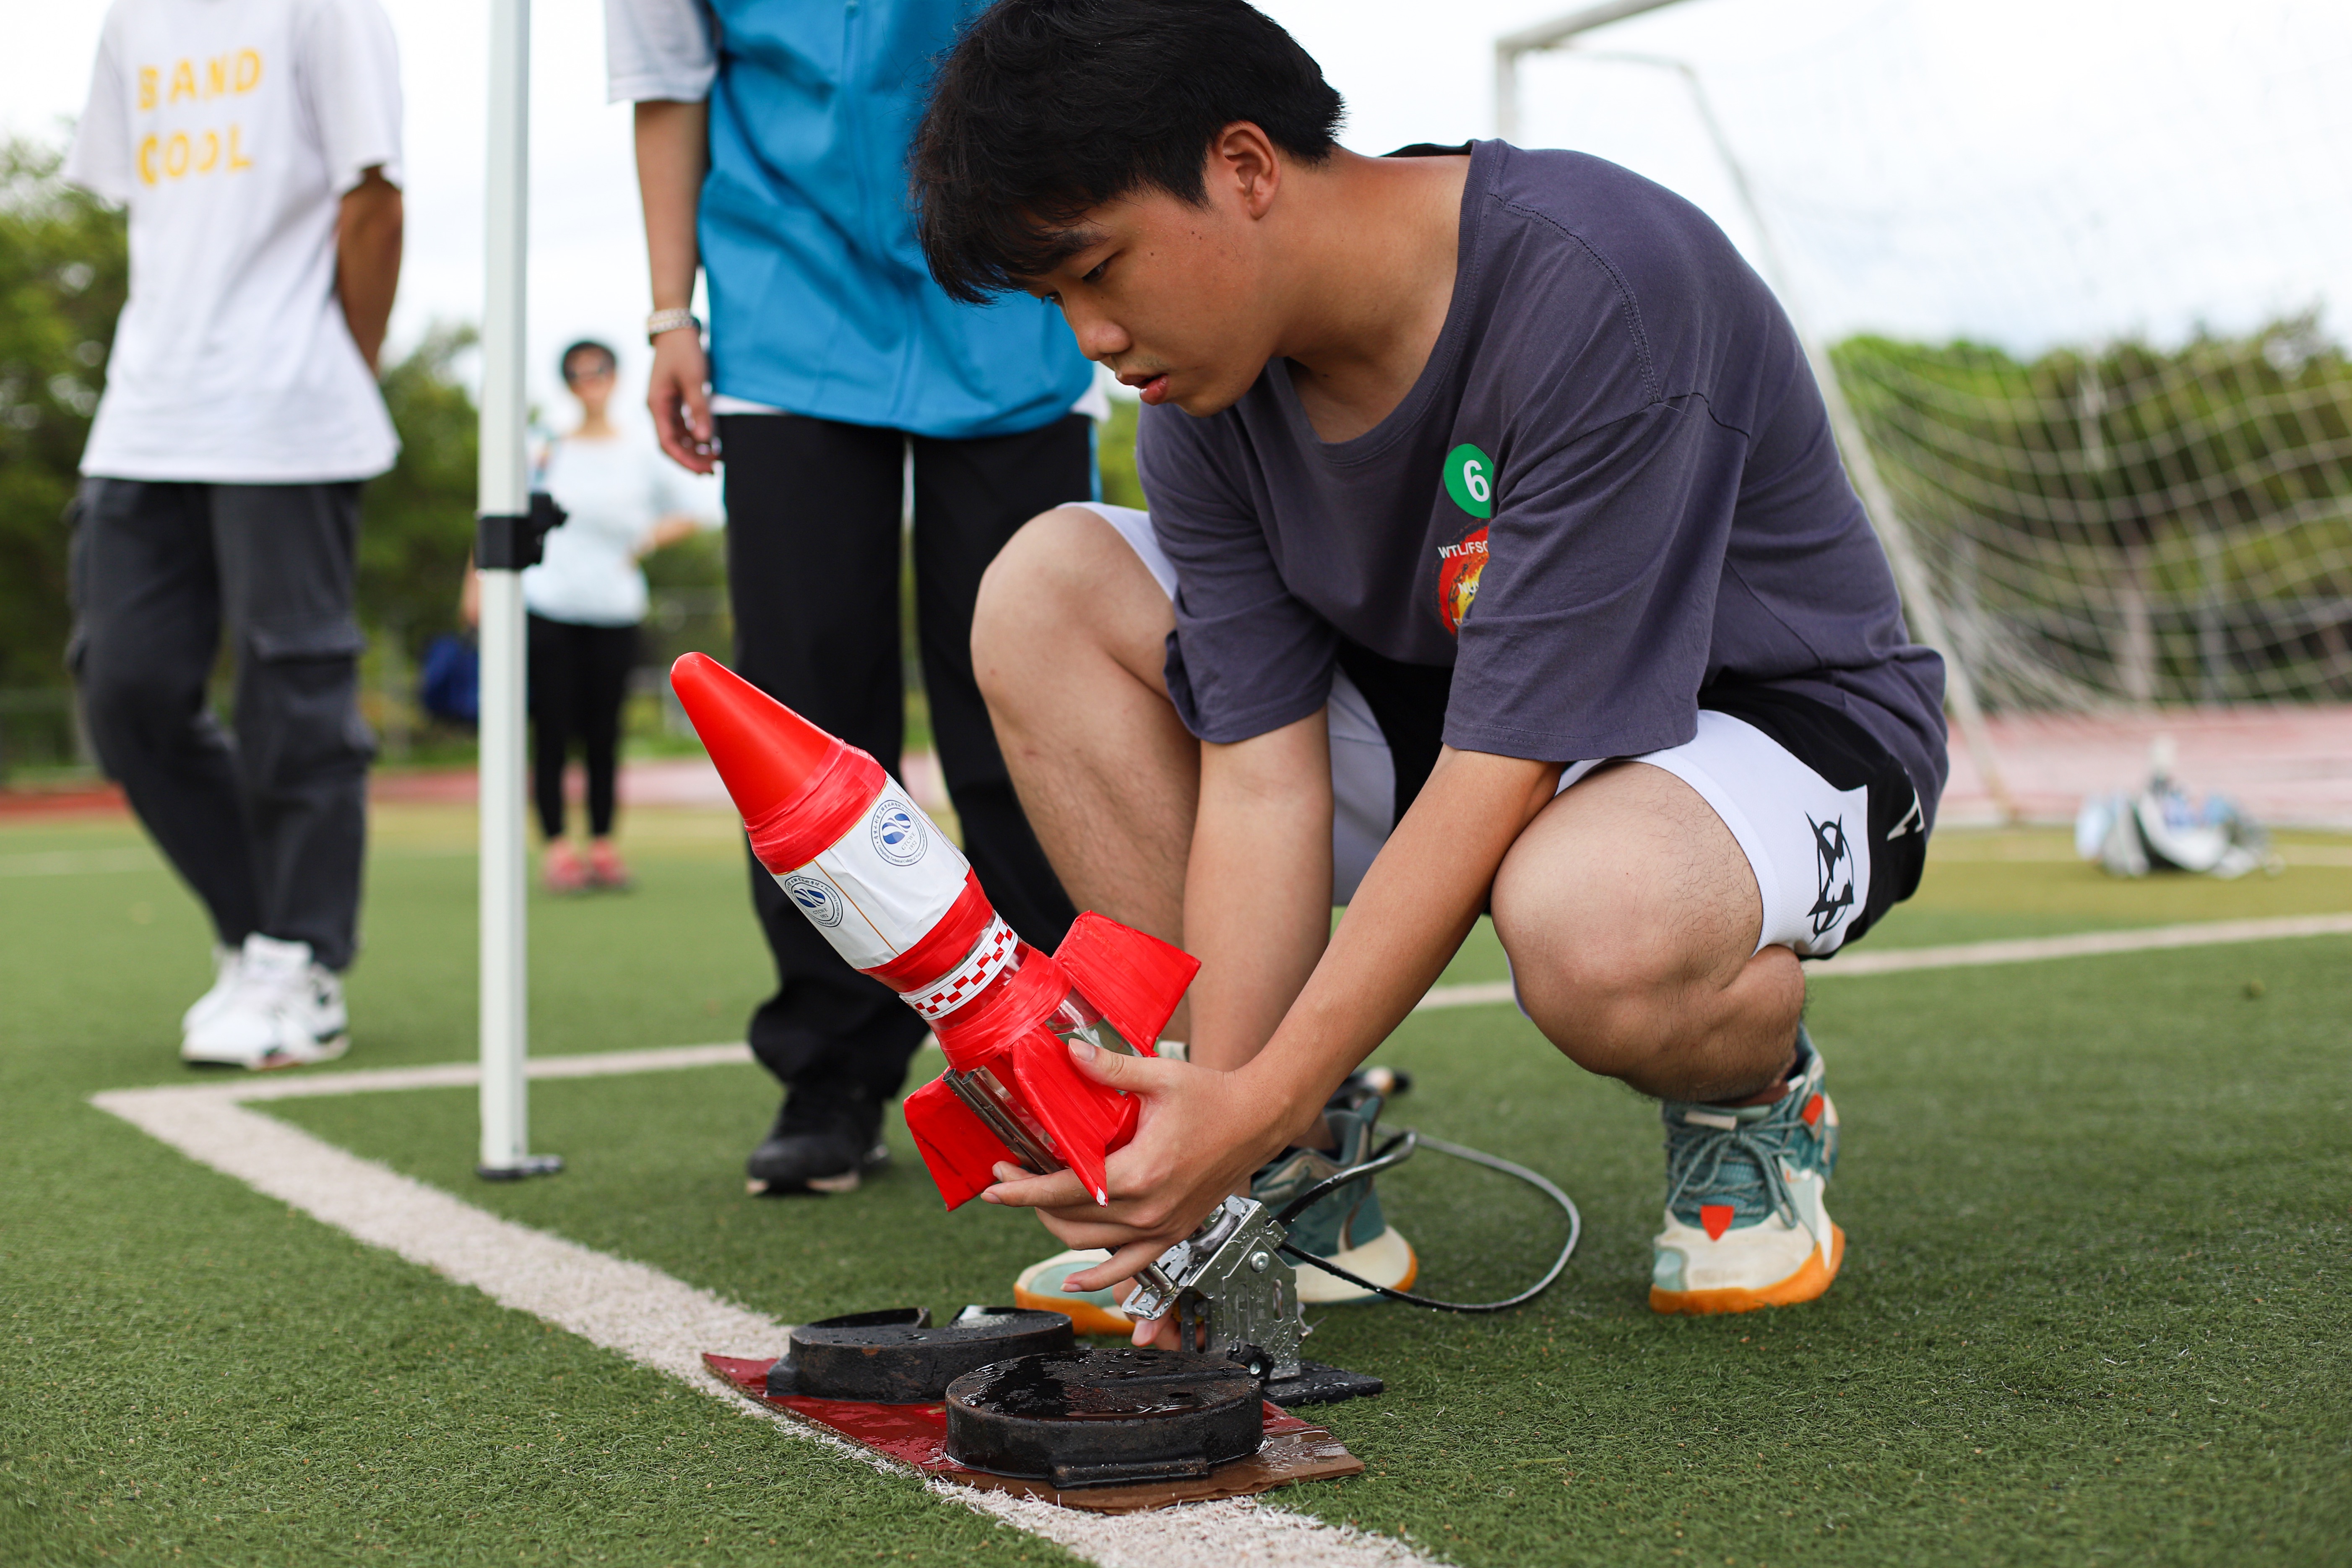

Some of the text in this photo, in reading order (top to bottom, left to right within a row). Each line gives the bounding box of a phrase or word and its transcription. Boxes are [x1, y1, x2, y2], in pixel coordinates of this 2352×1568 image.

[138, 49, 261, 110] BAND
[137, 123, 252, 186] COOL
[1463, 460, 1490, 502] 6
[901, 831, 916, 850] GTCWE
[908, 840, 917, 851] 1952
